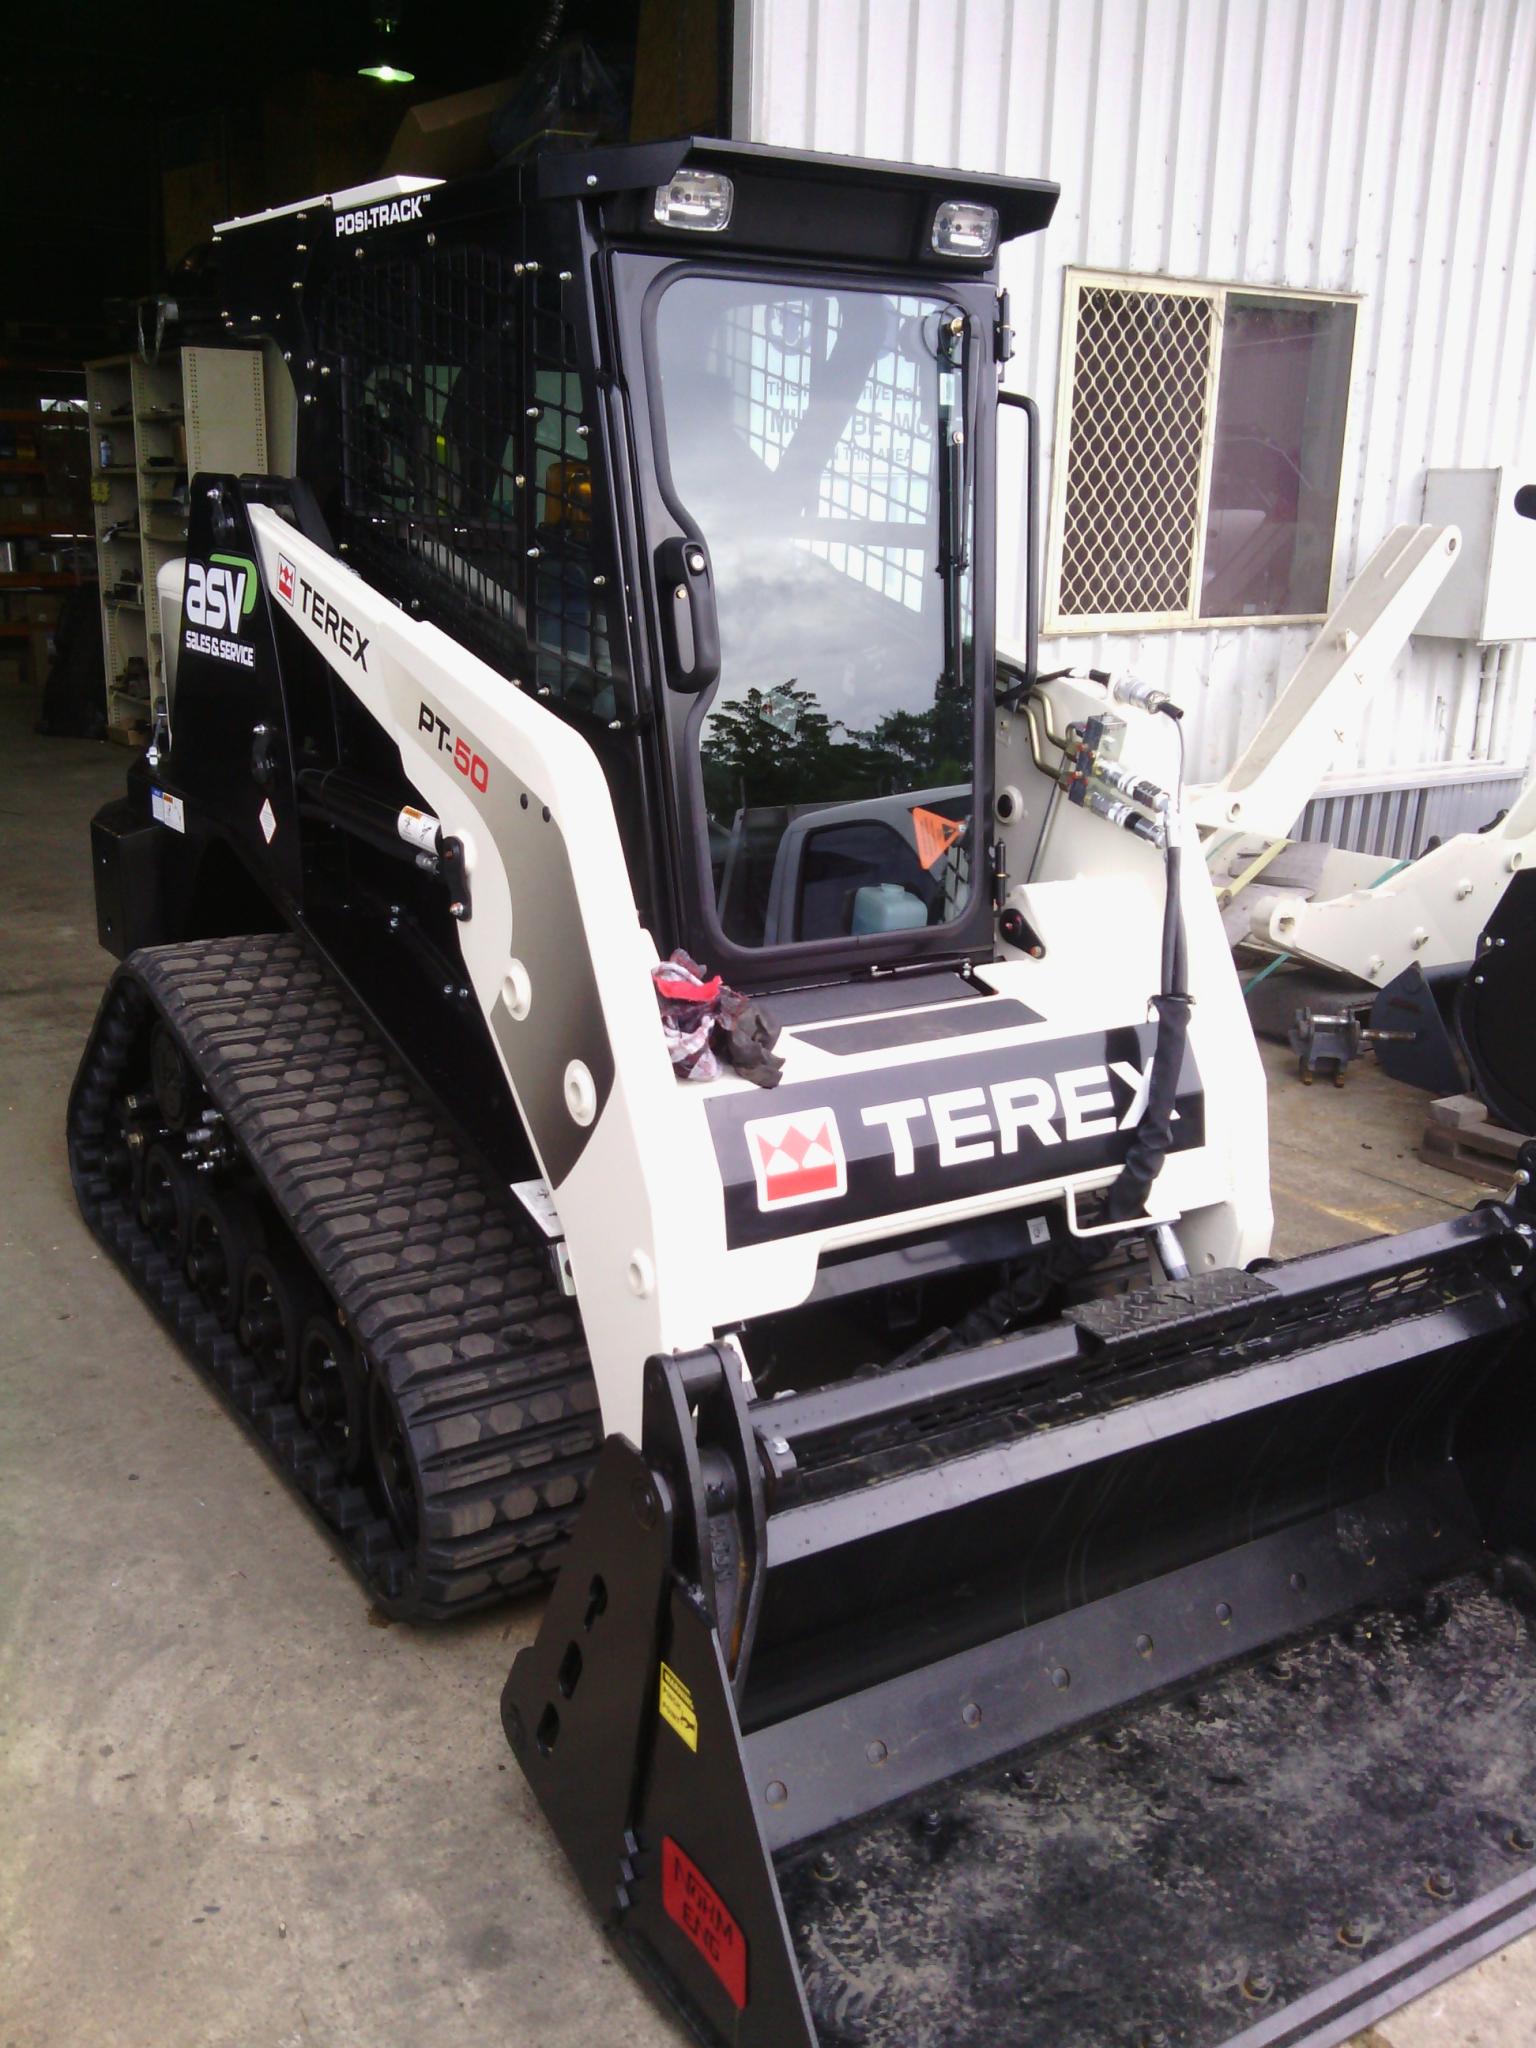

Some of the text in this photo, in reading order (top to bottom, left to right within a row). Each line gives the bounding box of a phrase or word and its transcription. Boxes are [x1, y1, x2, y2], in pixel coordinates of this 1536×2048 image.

[211, 637, 220, 657] &
[300, 578, 370, 673] TEREX
[418, 701, 489, 793] PT-50
[860, 1057, 1181, 1176] TEREX
